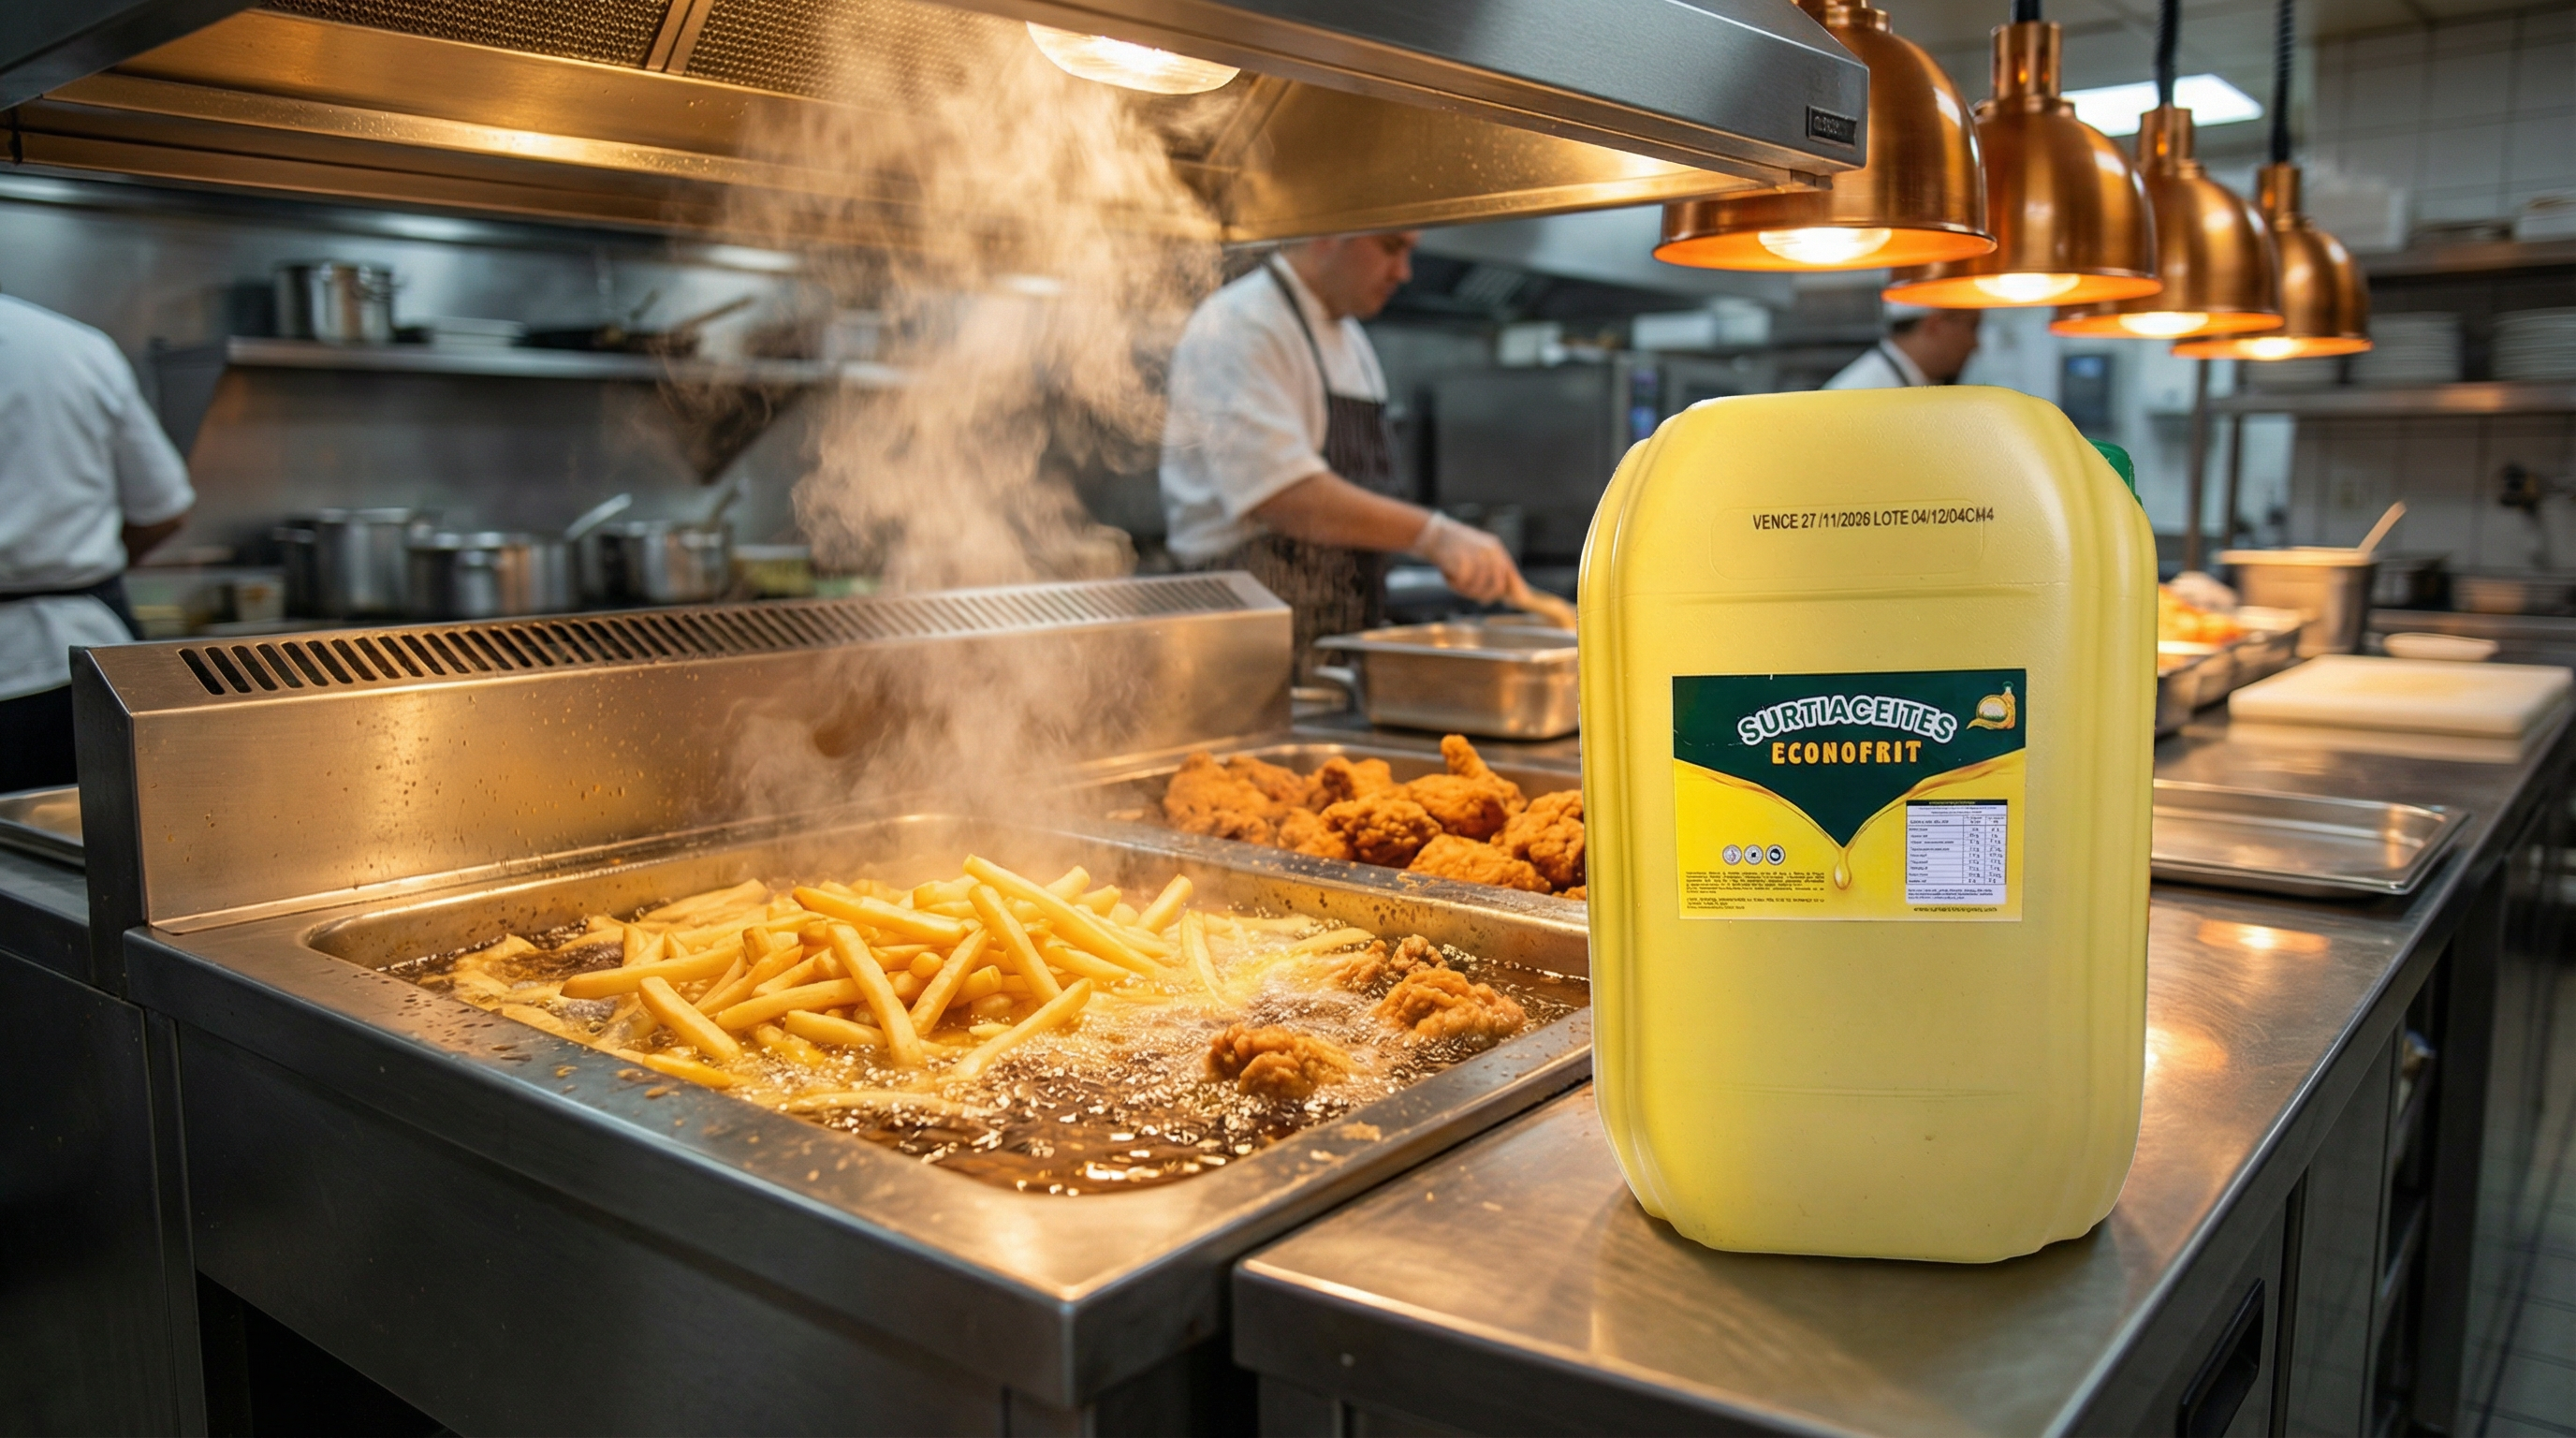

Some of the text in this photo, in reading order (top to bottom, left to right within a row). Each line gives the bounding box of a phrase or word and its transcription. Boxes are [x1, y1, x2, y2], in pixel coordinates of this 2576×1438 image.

[1752, 514, 1798, 530] VENCE
[1874, 509, 1909, 526] LOTE
[1737, 695, 1958, 745] SURTIACEITES
[1771, 741, 1923, 766] ECONOFRIT
